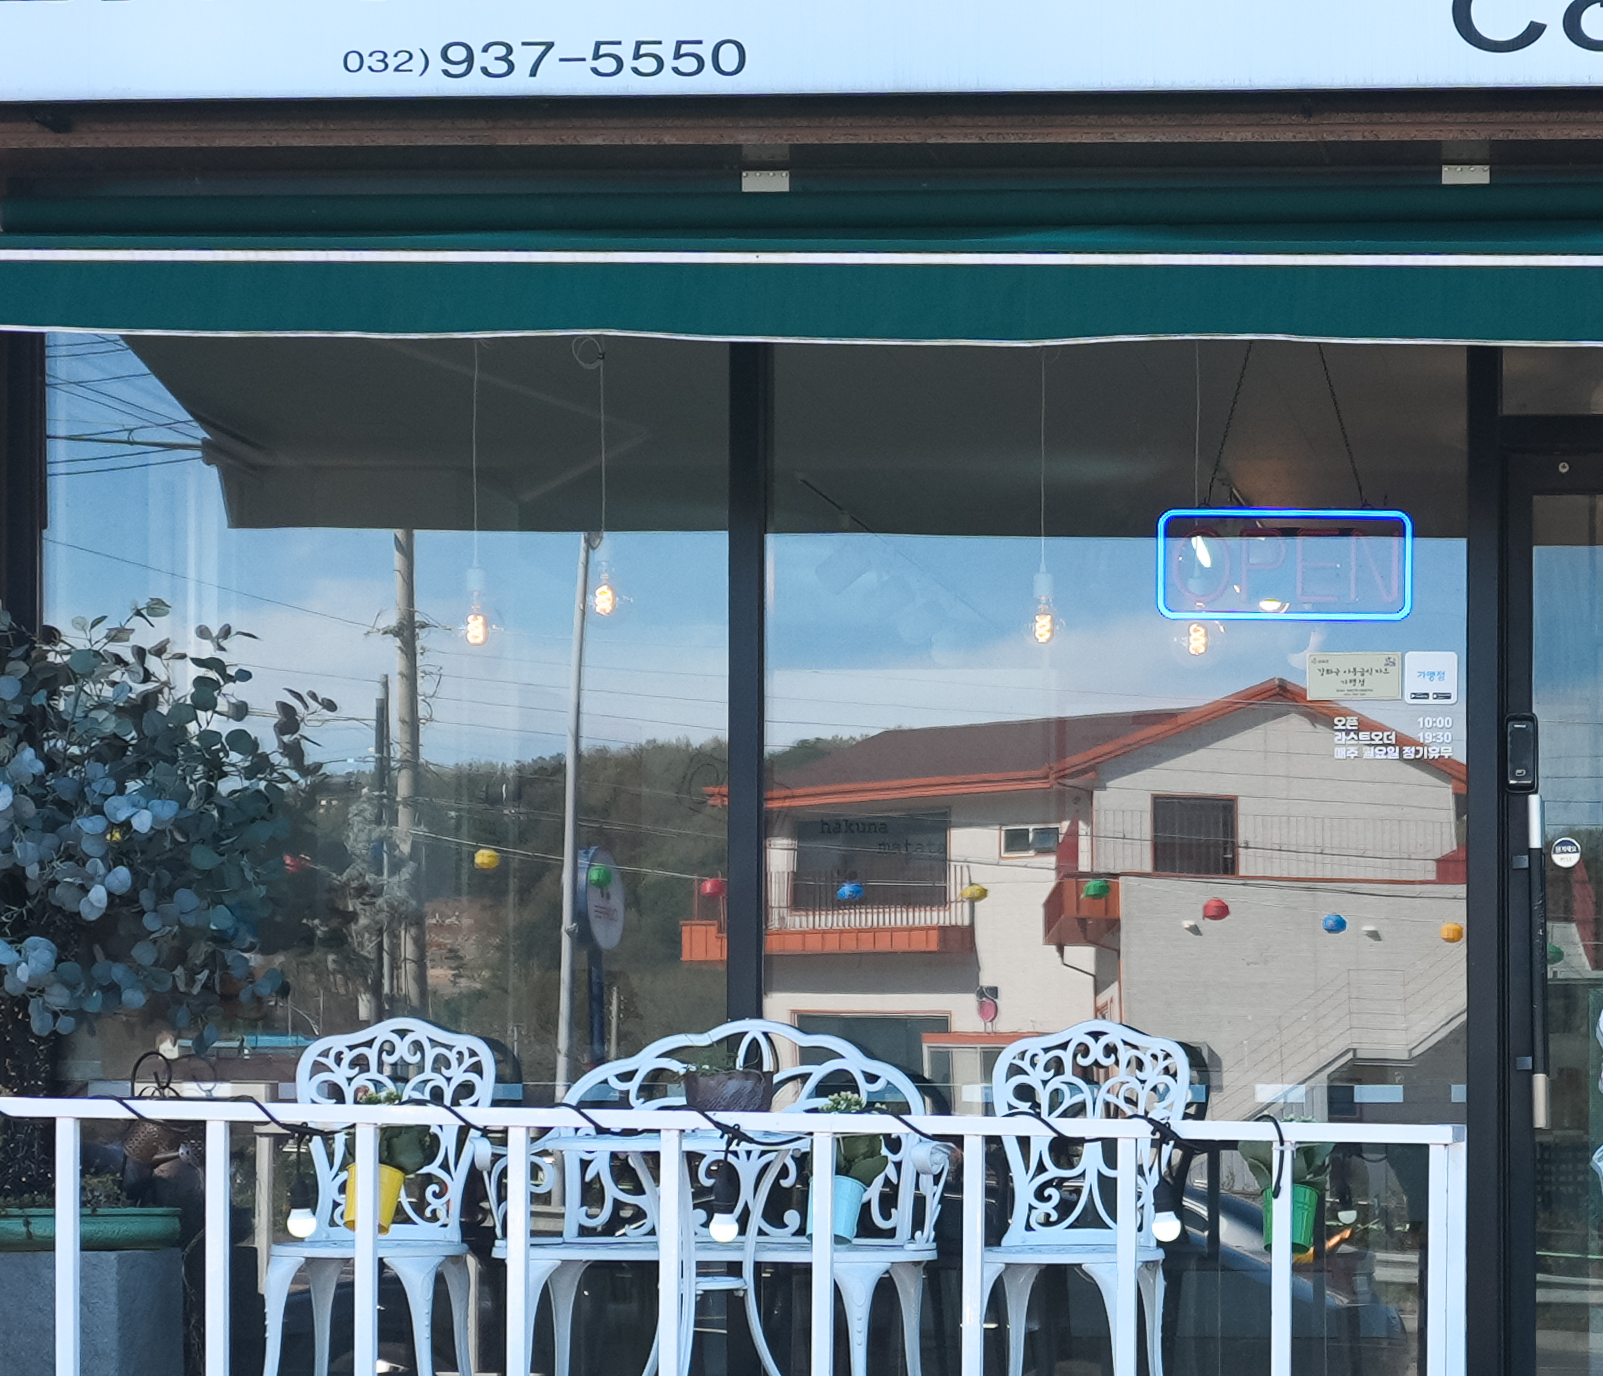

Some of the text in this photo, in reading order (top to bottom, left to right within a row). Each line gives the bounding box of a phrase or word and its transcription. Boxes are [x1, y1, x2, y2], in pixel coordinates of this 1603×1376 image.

[1173, 526, 1399, 604] OPEN
[1416, 670, 1446, 682] 가맹점
[1333, 716, 1453, 730] 오픈 10:00
[1334, 731, 1453, 744] 라스트오더 19:30
[1333, 745, 1359, 759] 매주
[1402, 745, 1454, 760] 정기휴무
[819, 819, 889, 835] hakuna
